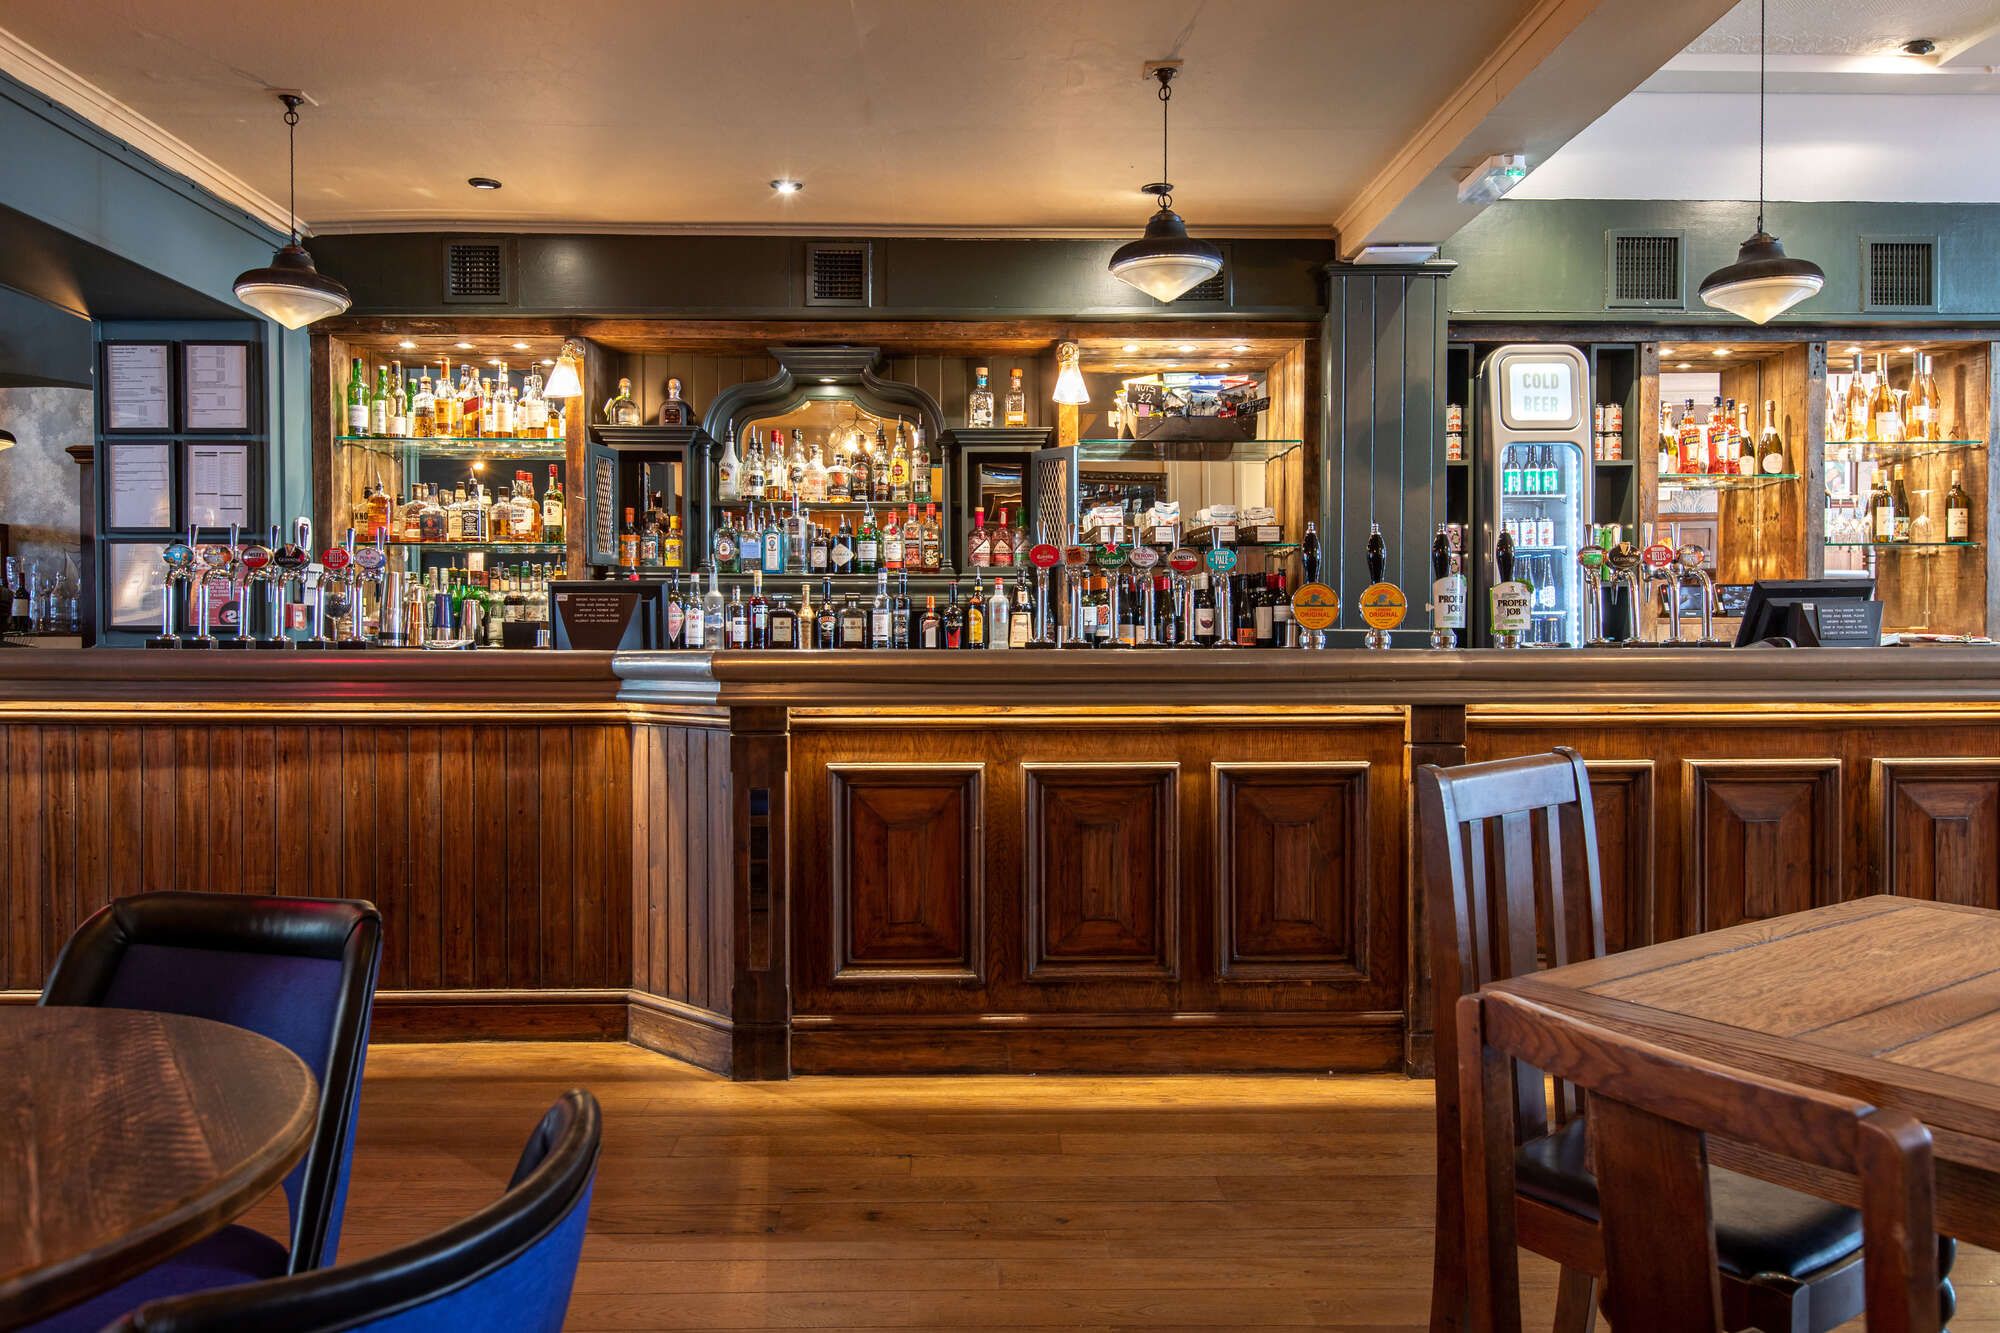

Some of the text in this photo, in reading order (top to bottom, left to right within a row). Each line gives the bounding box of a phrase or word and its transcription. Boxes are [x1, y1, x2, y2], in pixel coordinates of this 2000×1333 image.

[1522, 373, 1559, 389] COLD
[1135, 384, 1156, 393] NUTS
[1138, 393, 1152, 403] £2
[1524, 396, 1559, 412] BEER
[354, 512, 369, 520] KNO
[1497, 599, 1528, 607] PROPER
[1506, 607, 1521, 617] JOB
